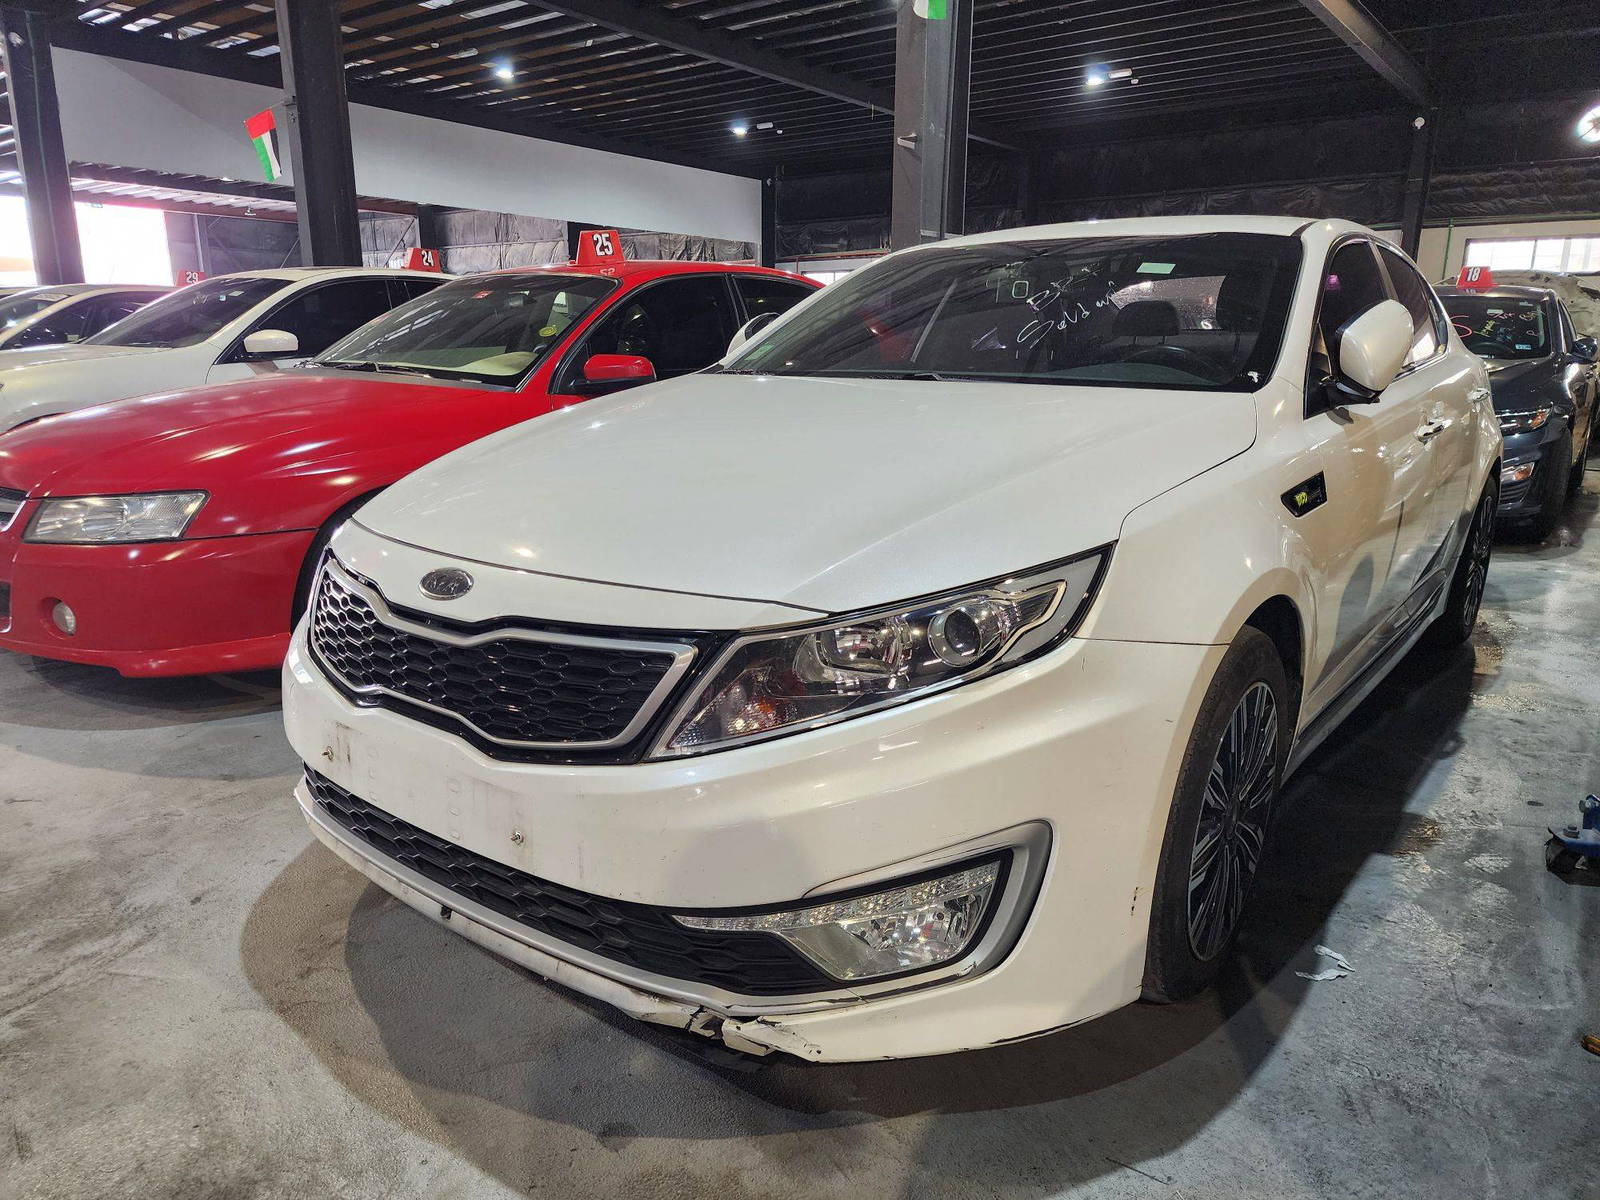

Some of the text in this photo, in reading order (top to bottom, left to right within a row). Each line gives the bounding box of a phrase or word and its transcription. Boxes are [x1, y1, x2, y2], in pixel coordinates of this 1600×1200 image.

[593, 233, 615, 256] 25
[421, 249, 434, 267] 24
[185, 271, 199, 285] 29
[1466, 266, 1481, 282] 18
